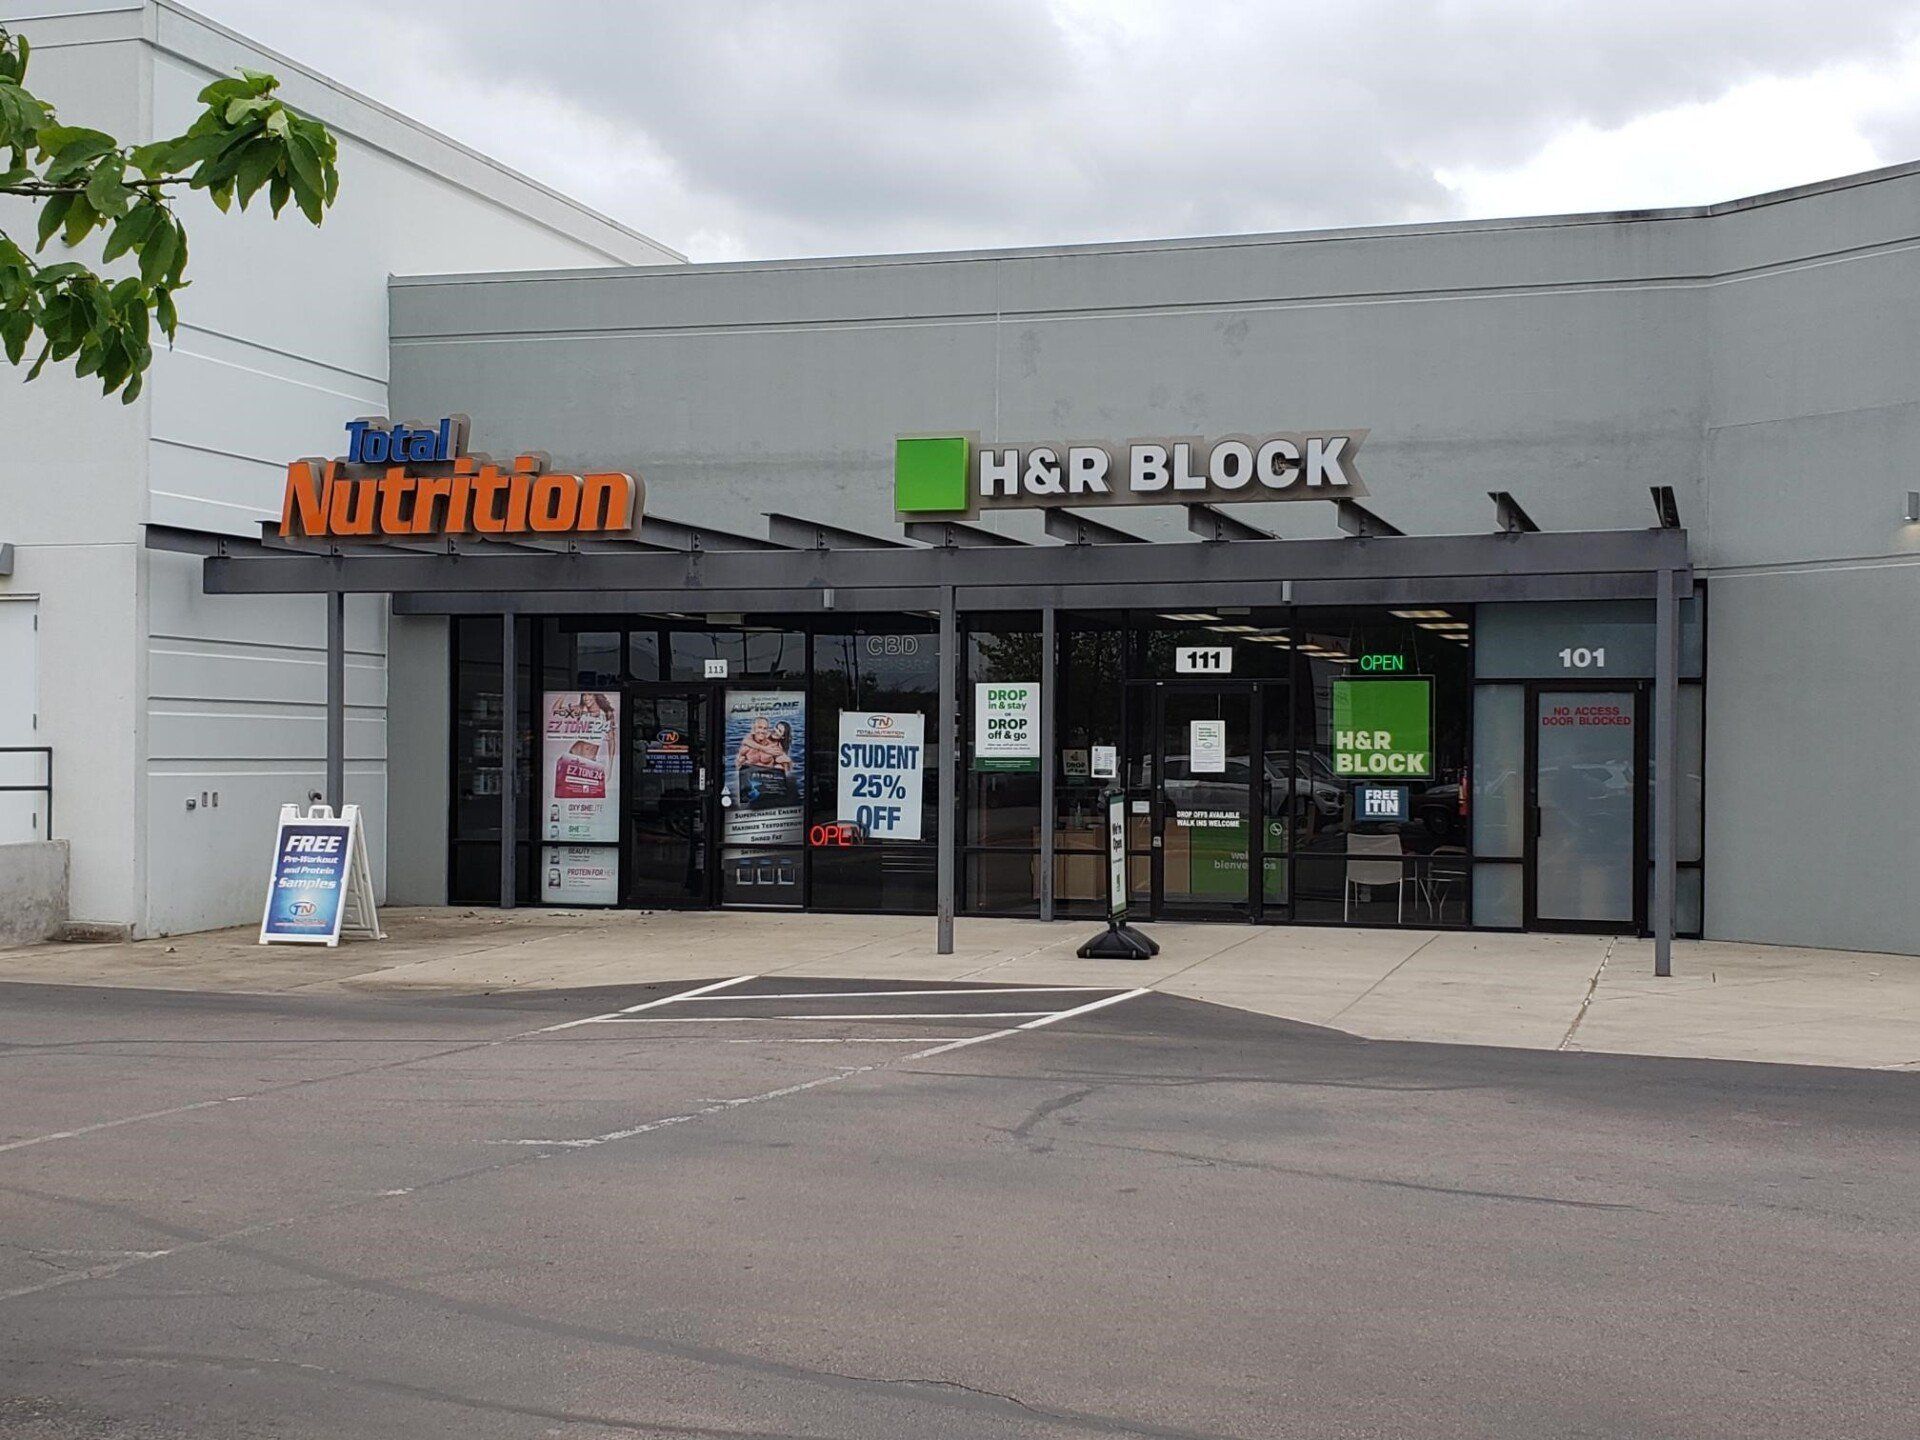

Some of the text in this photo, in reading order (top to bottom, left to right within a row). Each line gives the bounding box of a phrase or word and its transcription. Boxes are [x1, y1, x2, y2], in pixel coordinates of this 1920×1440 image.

[345, 417, 463, 463] Total
[978, 437, 1351, 496] H&R BLOCK
[279, 456, 637, 537] Nutrition
[867, 635, 919, 656] CBD
[1187, 651, 1221, 669] 111
[1360, 654, 1404, 671] OPEN
[1558, 647, 1605, 668] 101
[708, 665, 724, 674] 113
[988, 690, 1028, 701] DROP
[988, 701, 1027, 711] in & stay
[1553, 706, 1620, 716] NO ACCESS
[988, 719, 1028, 730] DROP
[1542, 716, 1632, 725] DOOR BLOCKED
[988, 730, 1027, 742] off & go
[1336, 730, 1392, 750] H&R
[840, 743, 920, 770] STUDENT
[1336, 753, 1425, 773] BLOCK
[852, 773, 906, 800] 25%
[1365, 789, 1399, 800] FREE
[1365, 800, 1399, 813] ITIN
[856, 804, 902, 831] OFF
[1176, 811, 1240, 819] DROP OFFS AVAILABLE
[1176, 819, 1195, 827] WALK
[1208, 819, 1240, 827] WELCOME
[285, 835, 342, 853] FREE
[283, 855, 339, 864] Pre-Workout
[284, 866, 335, 875] and Protein
[278, 877, 337, 890] Samples
